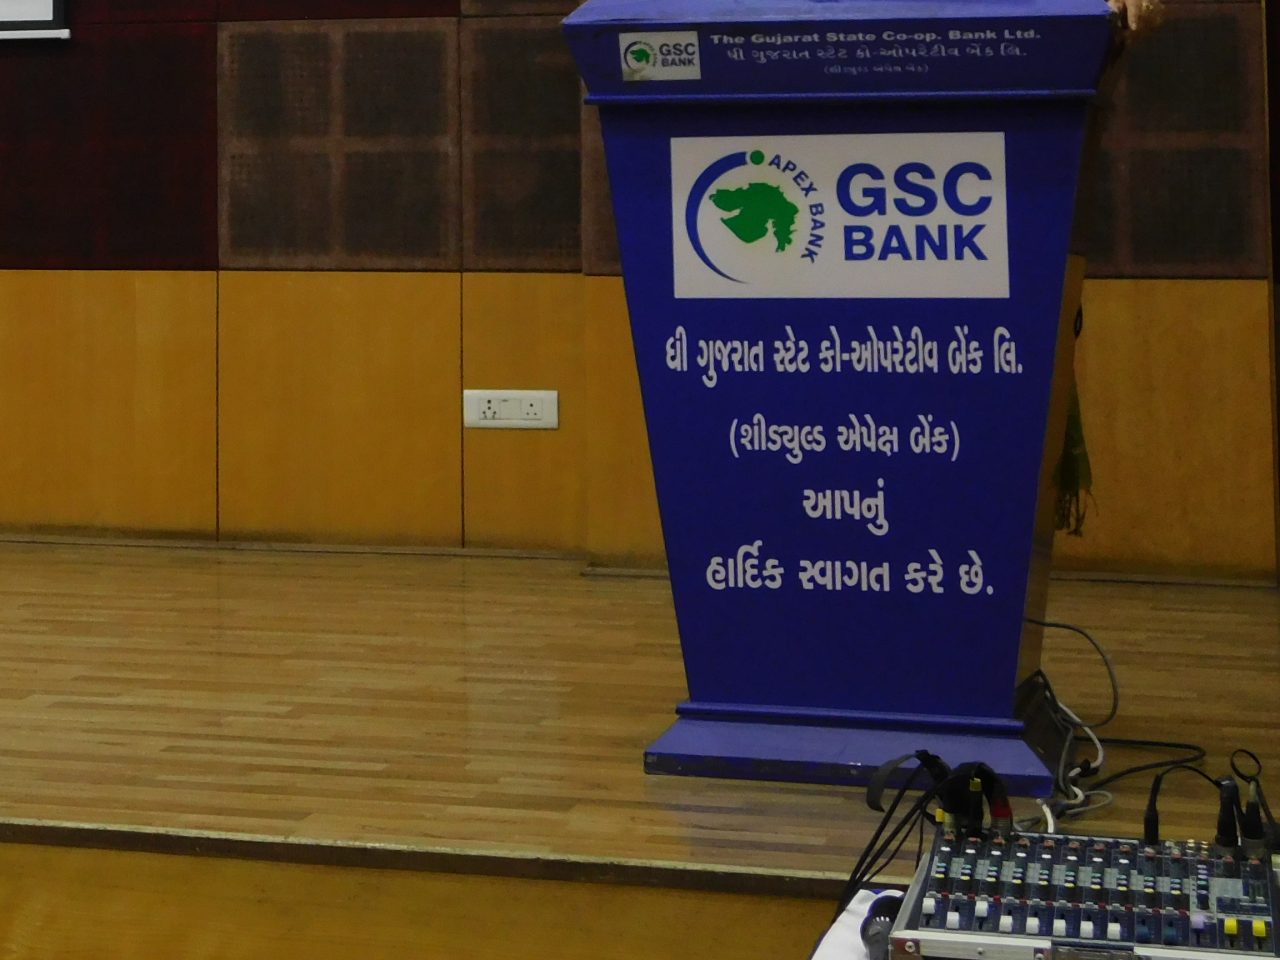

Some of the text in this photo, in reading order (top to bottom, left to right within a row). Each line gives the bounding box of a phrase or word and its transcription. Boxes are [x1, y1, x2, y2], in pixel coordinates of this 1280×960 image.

[659, 43, 696, 56] GSC
[661, 57, 696, 67] BANK
[710, 29, 1041, 45] The Gujarat State Co-op. Bank Ltd.
[768, 153, 825, 265] APEX BANK
[835, 162, 994, 218] GSC
[844, 225, 988, 262] BANK
[666, 325, 1023, 388] ધી ગુજરાત સ્ટેટ કો-ઓપરેટીવ બેંક લિ.
[729, 413, 960, 464] (શીડ્યુલ્ડ એપેક્ષ બેંક)
[803, 477, 889, 536] આપનું
[706, 540, 993, 595] હાર્દિક સ્વાગત કરે છે.
